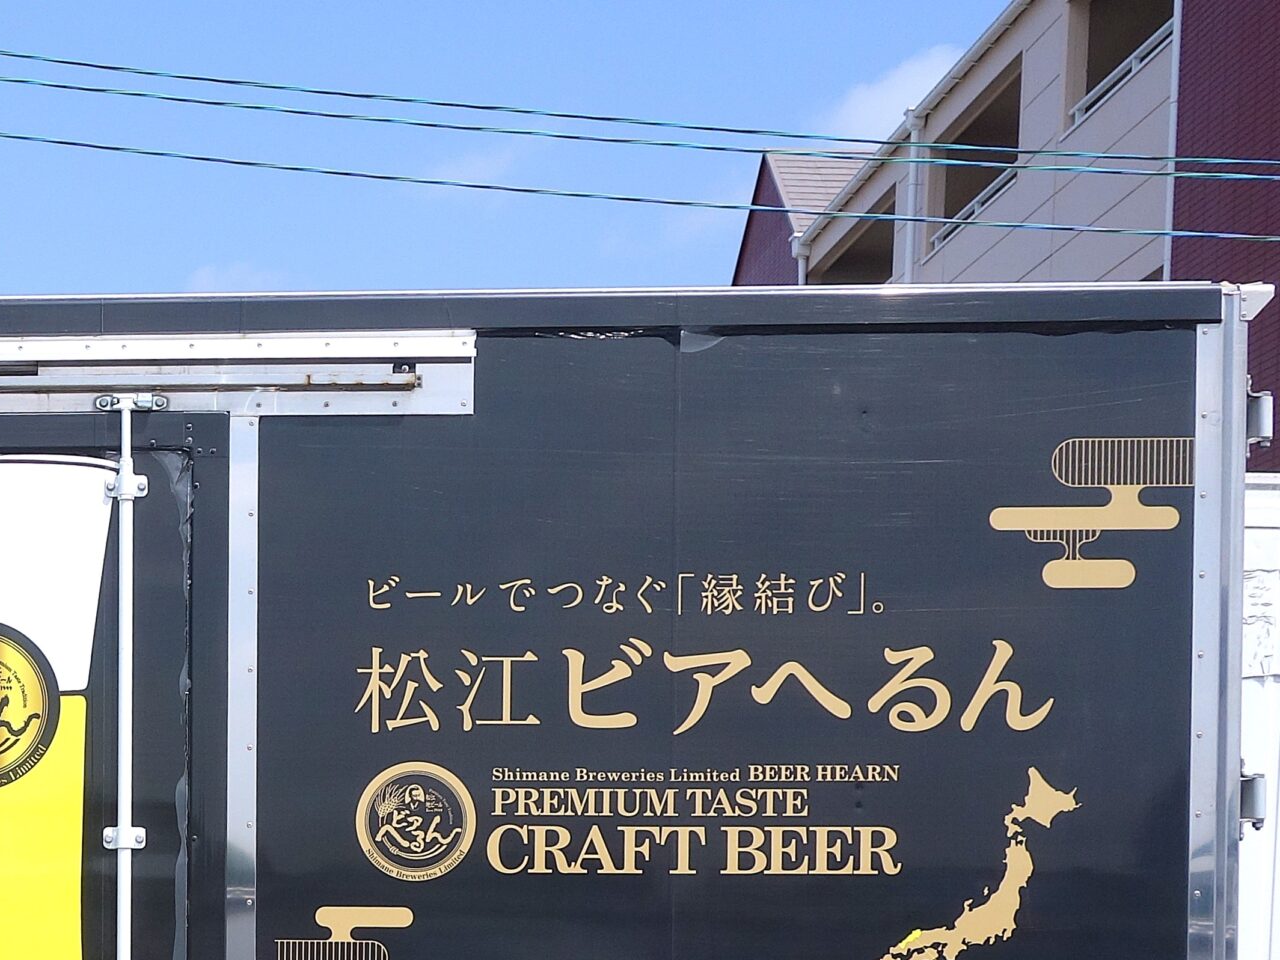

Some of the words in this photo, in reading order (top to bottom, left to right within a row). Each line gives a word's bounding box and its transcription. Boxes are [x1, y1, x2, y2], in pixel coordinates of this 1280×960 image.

[367, 572, 884, 616] ビールでつなぐ「縁結び」。
[9, 743, 48, 781] Limited
[491, 766, 570, 782] Shimane
[575, 766, 665, 782] Breweries
[669, 766, 741, 782] Limited
[747, 765, 811, 782] BEER
[815, 765, 901, 782] HEARN
[491, 788, 680, 817] PREMIUM
[685, 788, 809, 817] TASTE
[365, 847, 394, 875] Shimane
[395, 868, 438, 880] Breweries
[438, 848, 466, 874] Limited
[487, 824, 706, 876] CRAFT
[719, 824, 902, 875] BEER
